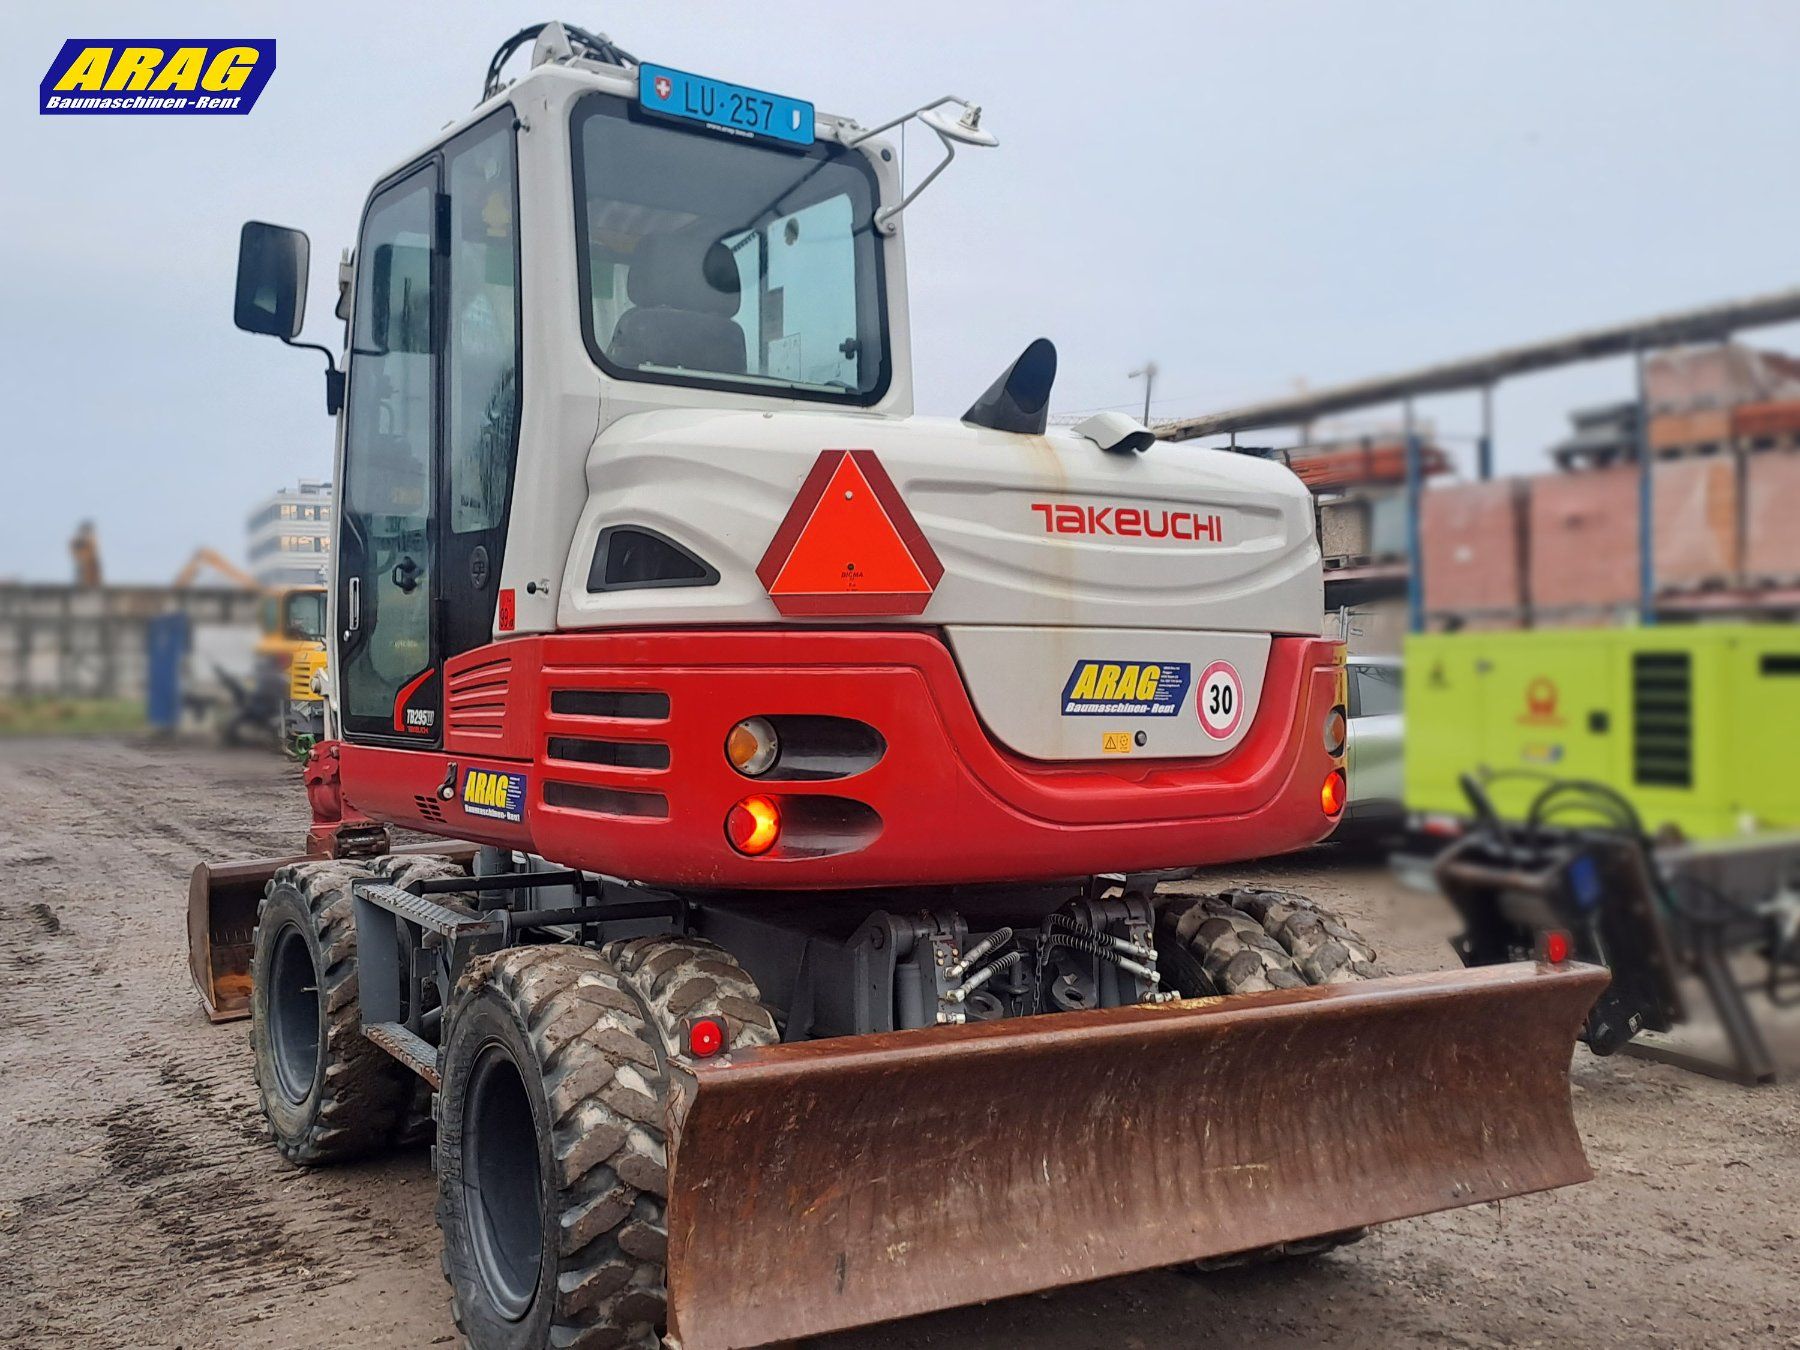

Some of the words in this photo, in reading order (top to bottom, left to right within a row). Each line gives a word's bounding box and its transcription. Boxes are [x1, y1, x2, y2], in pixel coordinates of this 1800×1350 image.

[1070, 664, 1161, 701] ARAG
[1209, 684, 1233, 715] 30
[464, 771, 509, 808] ARAG
